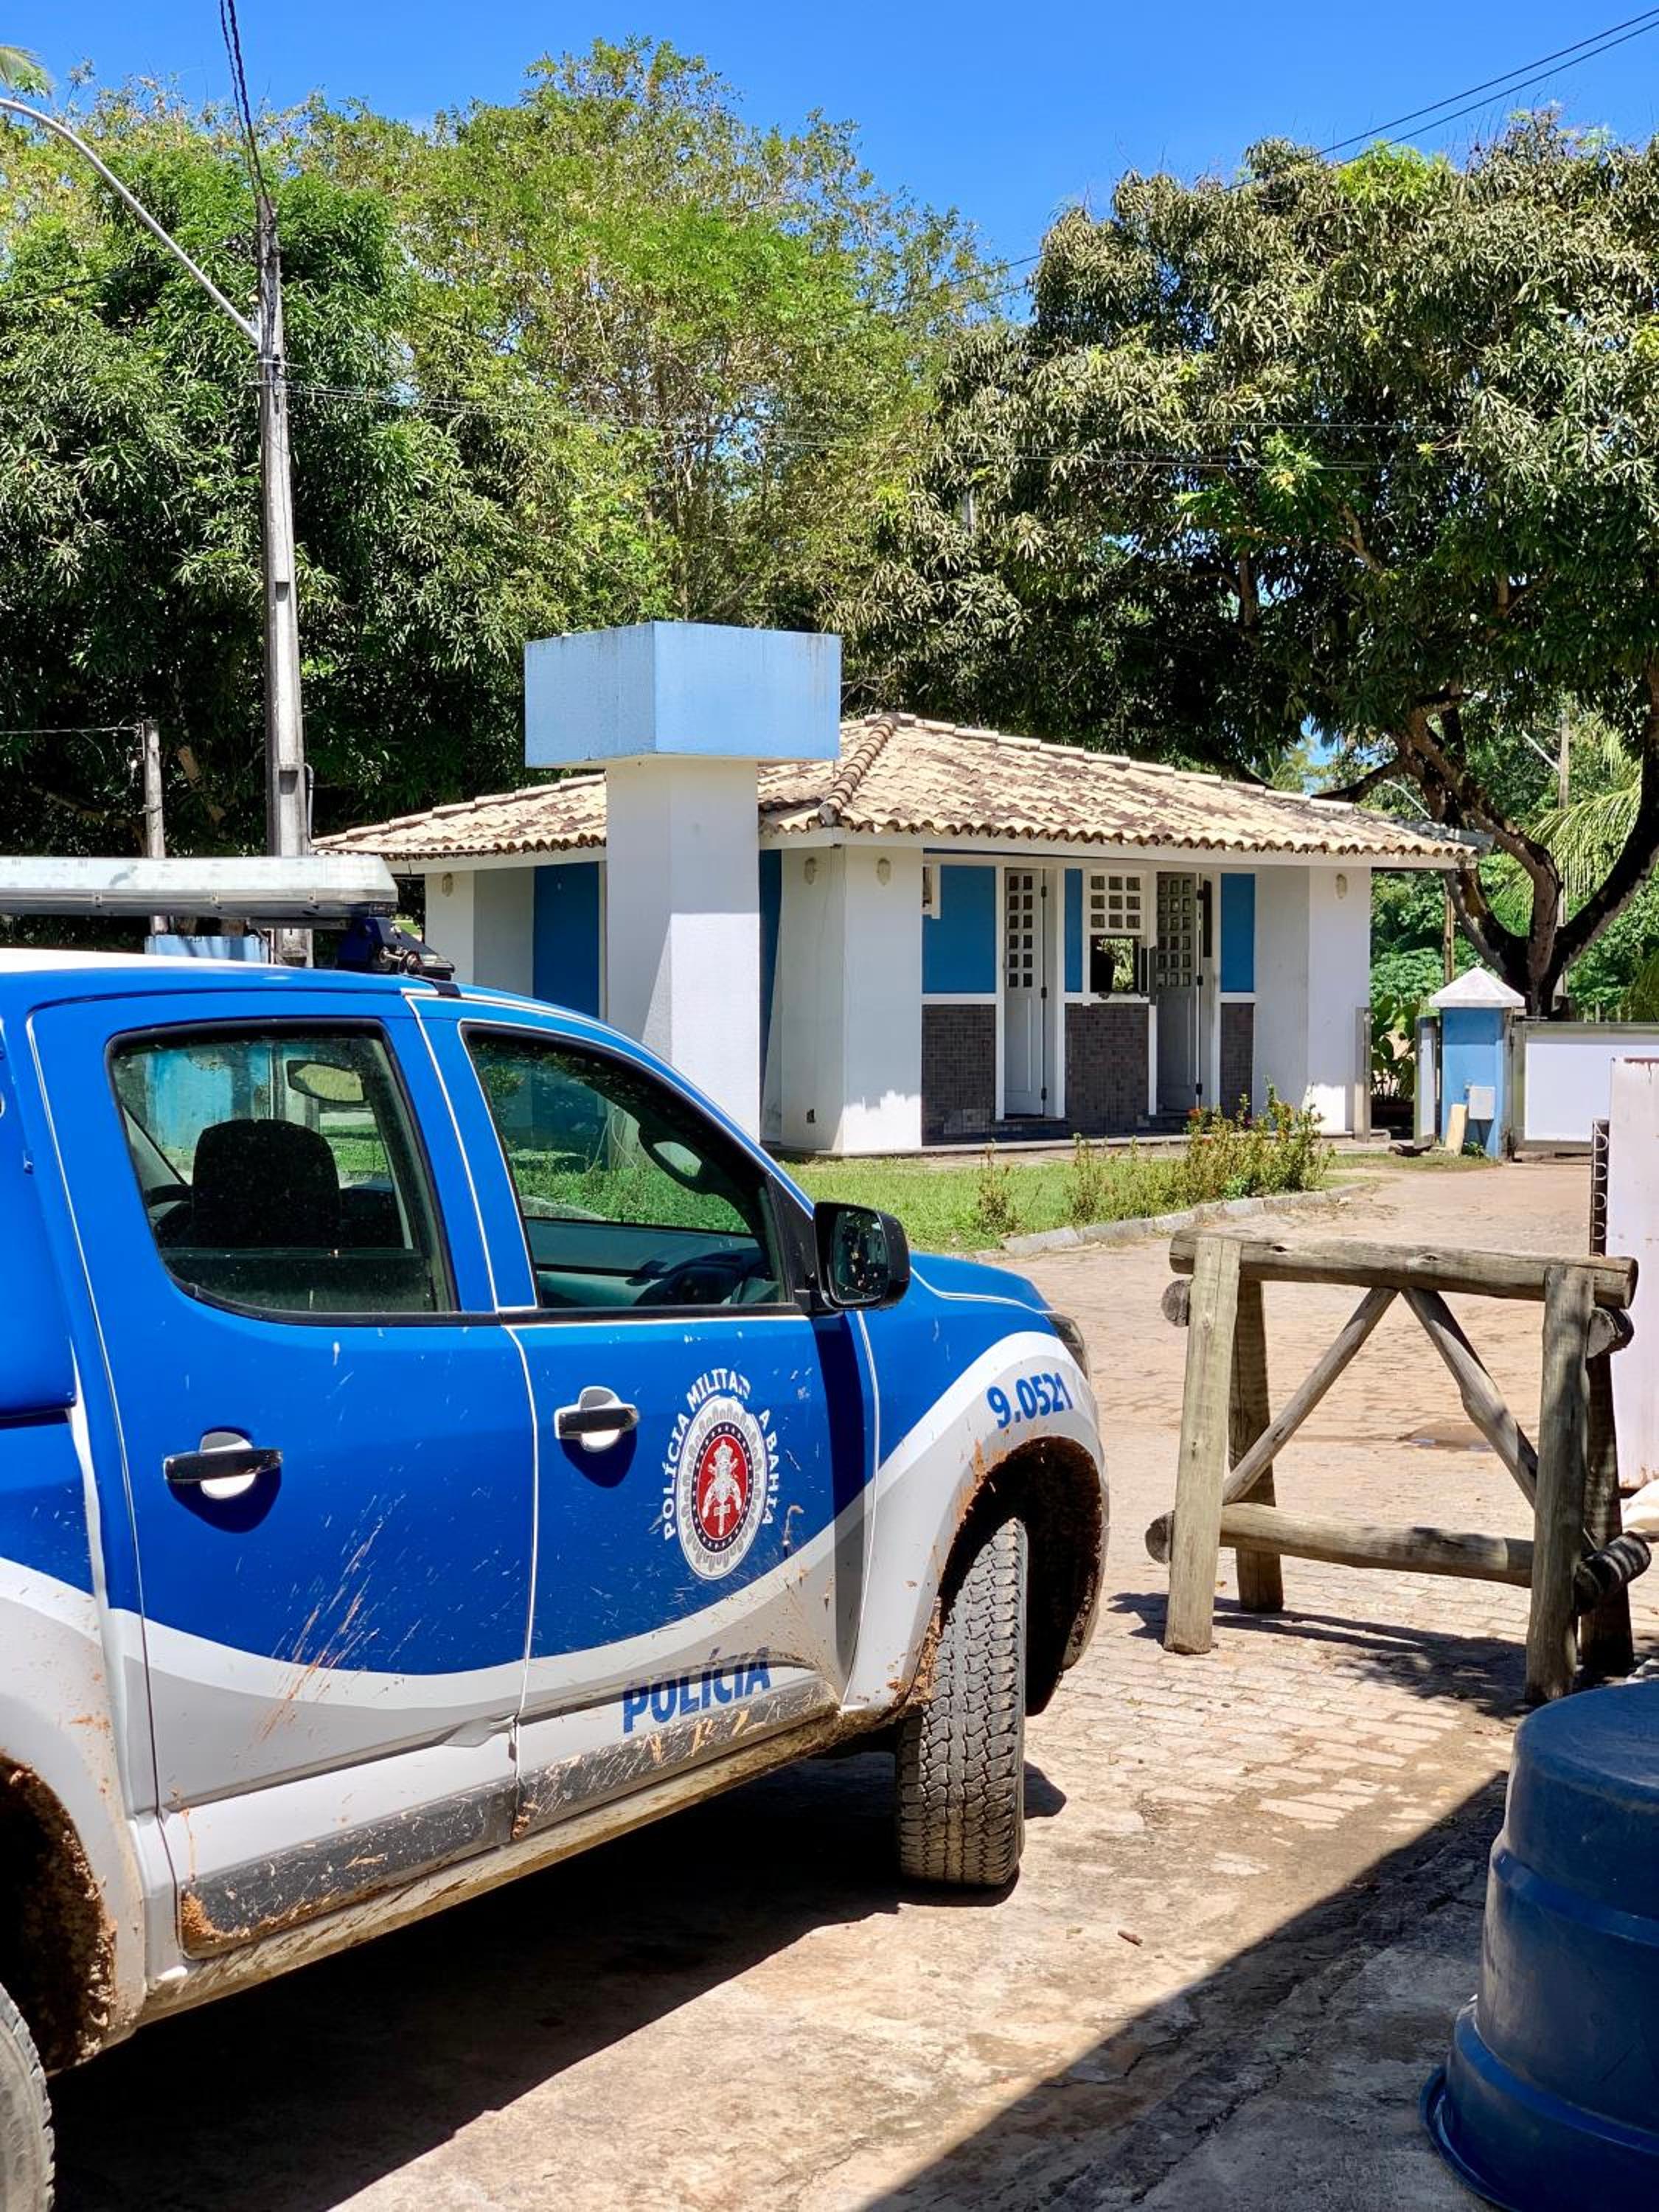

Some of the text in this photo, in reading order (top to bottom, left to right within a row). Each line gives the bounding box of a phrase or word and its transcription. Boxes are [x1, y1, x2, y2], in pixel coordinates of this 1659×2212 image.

[987, 1372, 1074, 1429] 9.0521
[661, 1413, 690, 1540] POLÍCIA
[762, 1430, 779, 1525] BAHIA
[622, 1645, 771, 1733] POLÍCIA
